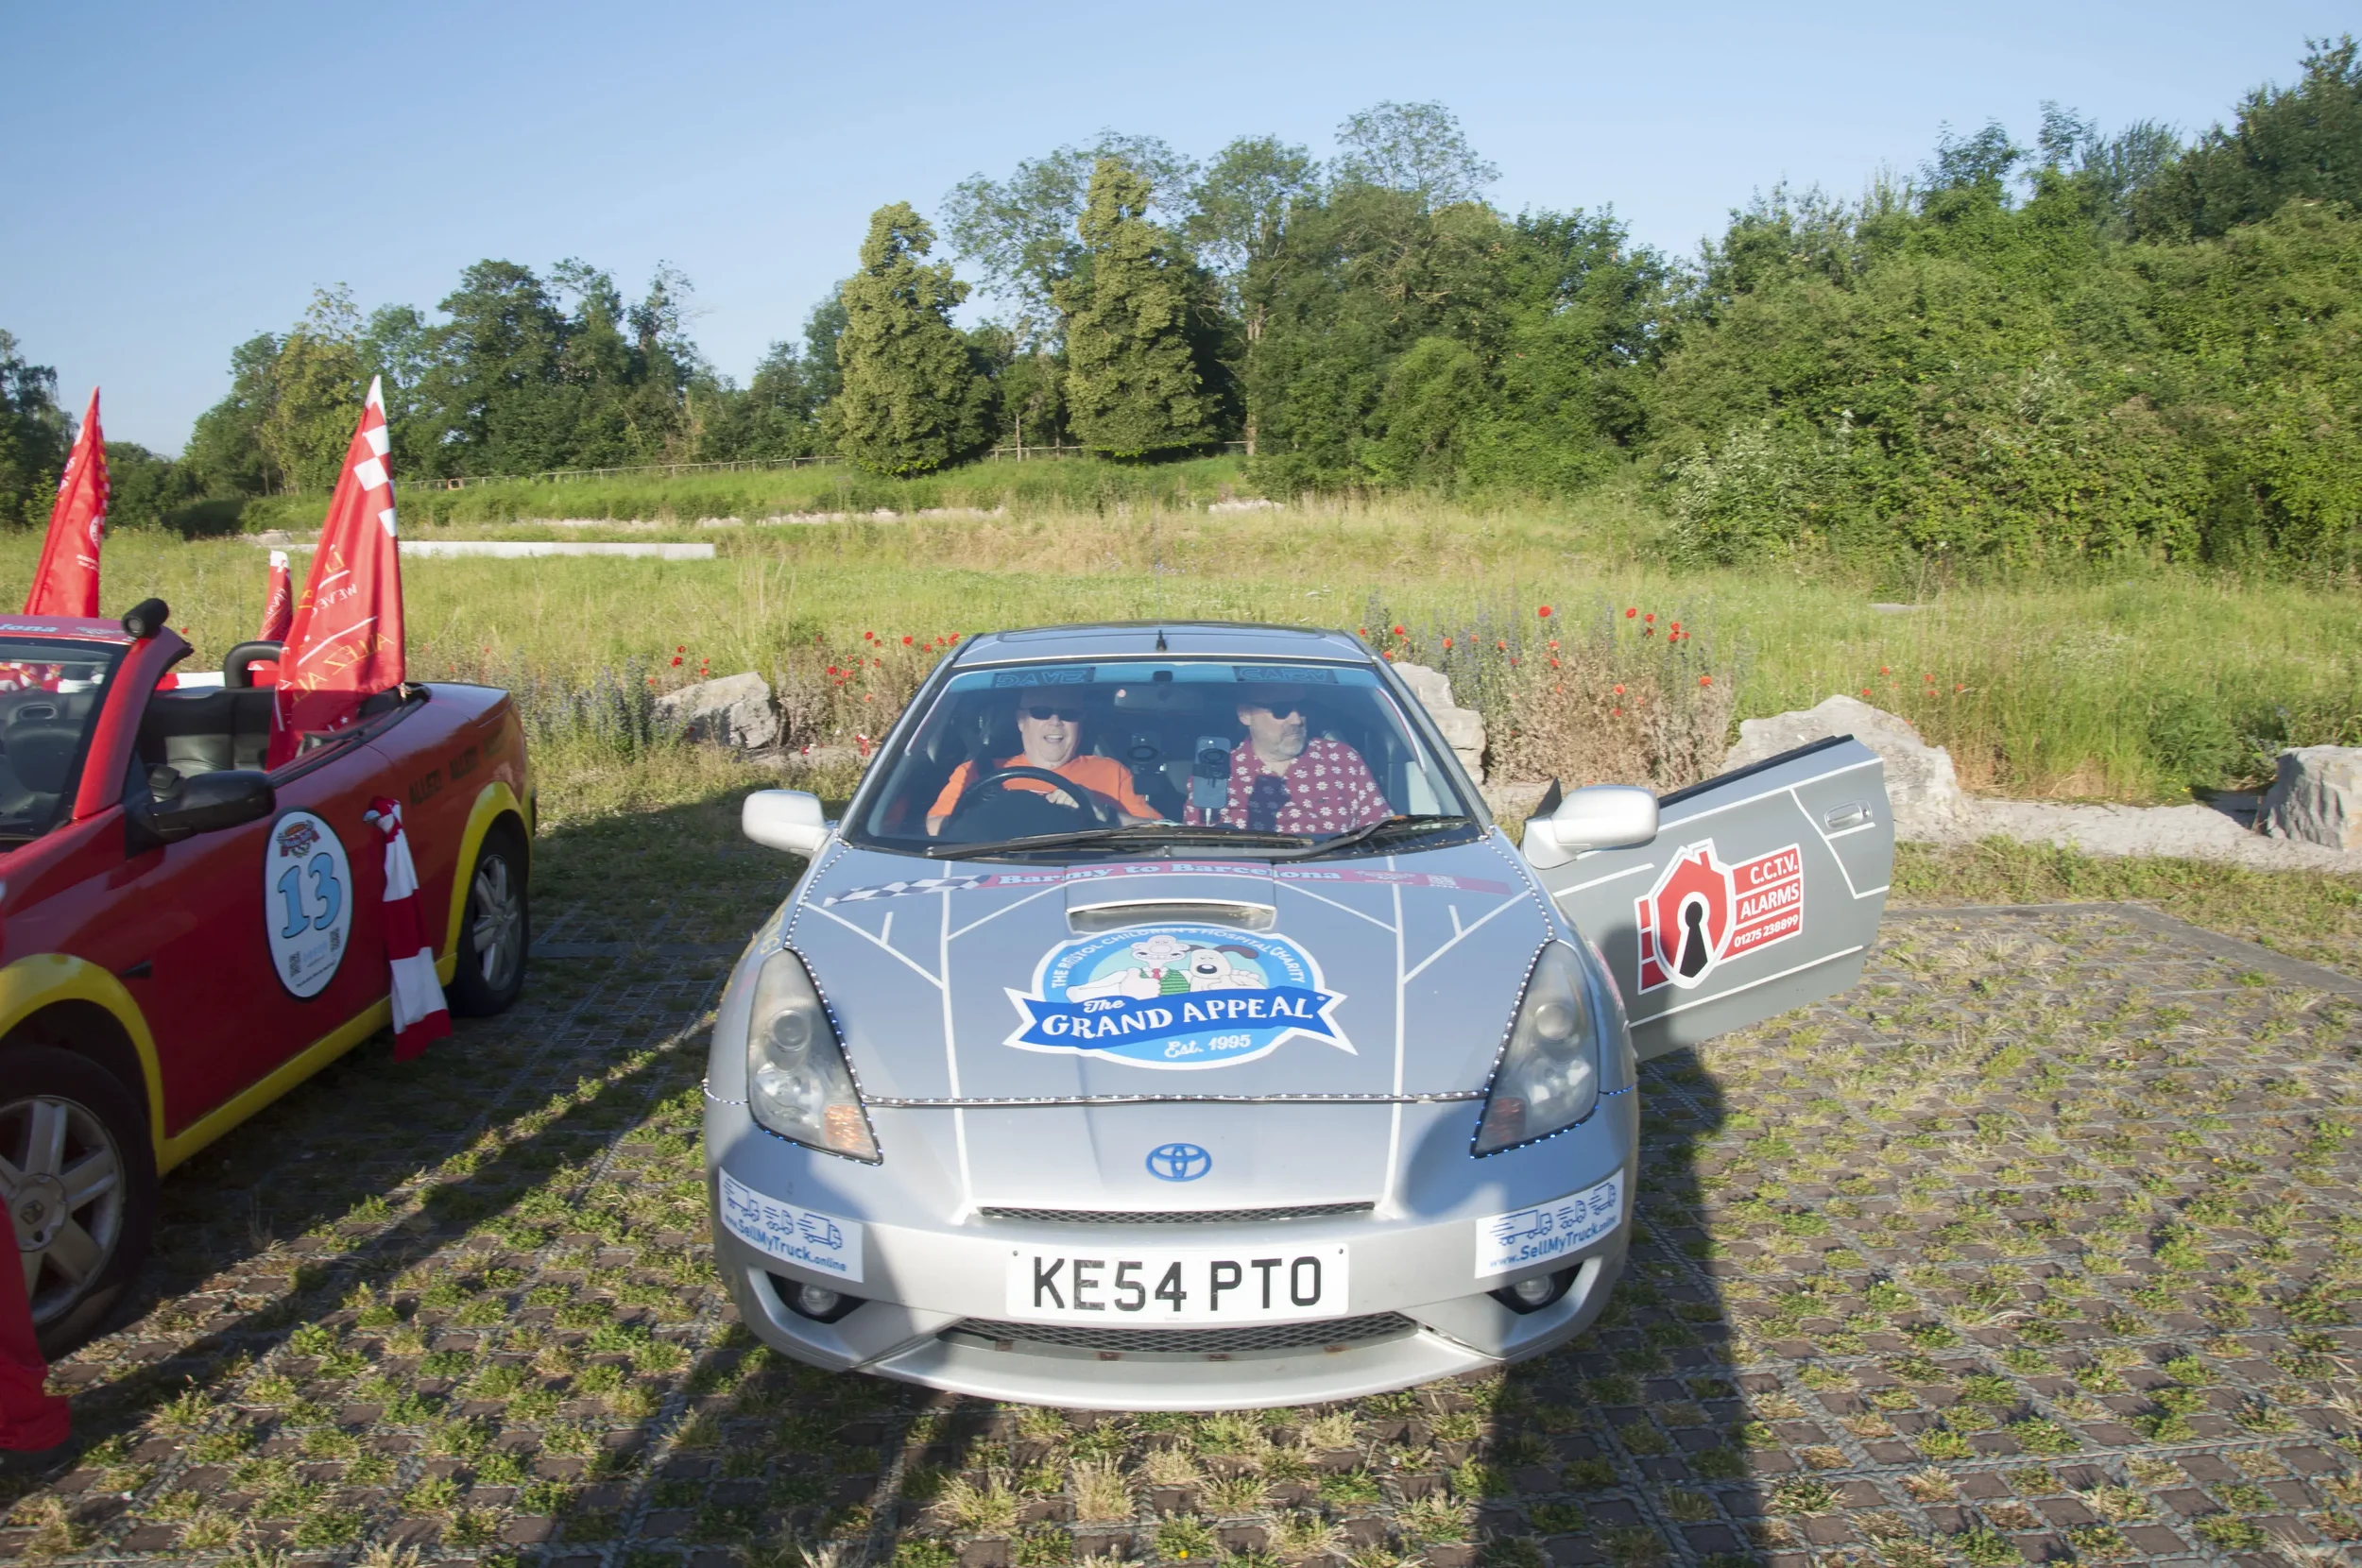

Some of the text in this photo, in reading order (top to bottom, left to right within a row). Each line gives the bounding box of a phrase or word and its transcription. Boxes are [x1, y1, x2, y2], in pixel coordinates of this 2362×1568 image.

[995, 670, 1087, 688] DAVE
[1240, 667, 1327, 681] GARY
[998, 866, 1114, 884] Barmy
[1123, 863, 1161, 875] to
[1170, 862, 1342, 879] Barcelona
[1750, 853, 1799, 885] C.C.T.V.
[278, 852, 341, 939] 13
[1739, 882, 1800, 920] ALARMS
[1201, 928, 1270, 952] HOSPITAL
[1734, 914, 1799, 947] 01275 238899
[1057, 945, 1104, 969] BRISTOL
[1269, 946, 1306, 983] CHARITY
[1051, 969, 1070, 989] THE
[1041, 995, 1313, 1039] GRAND APPEAL
[1083, 998, 1125, 1014] The
[1163, 1034, 1252, 1059] Est. 1995
[1035, 1256, 1322, 1312] KE54 PTO
